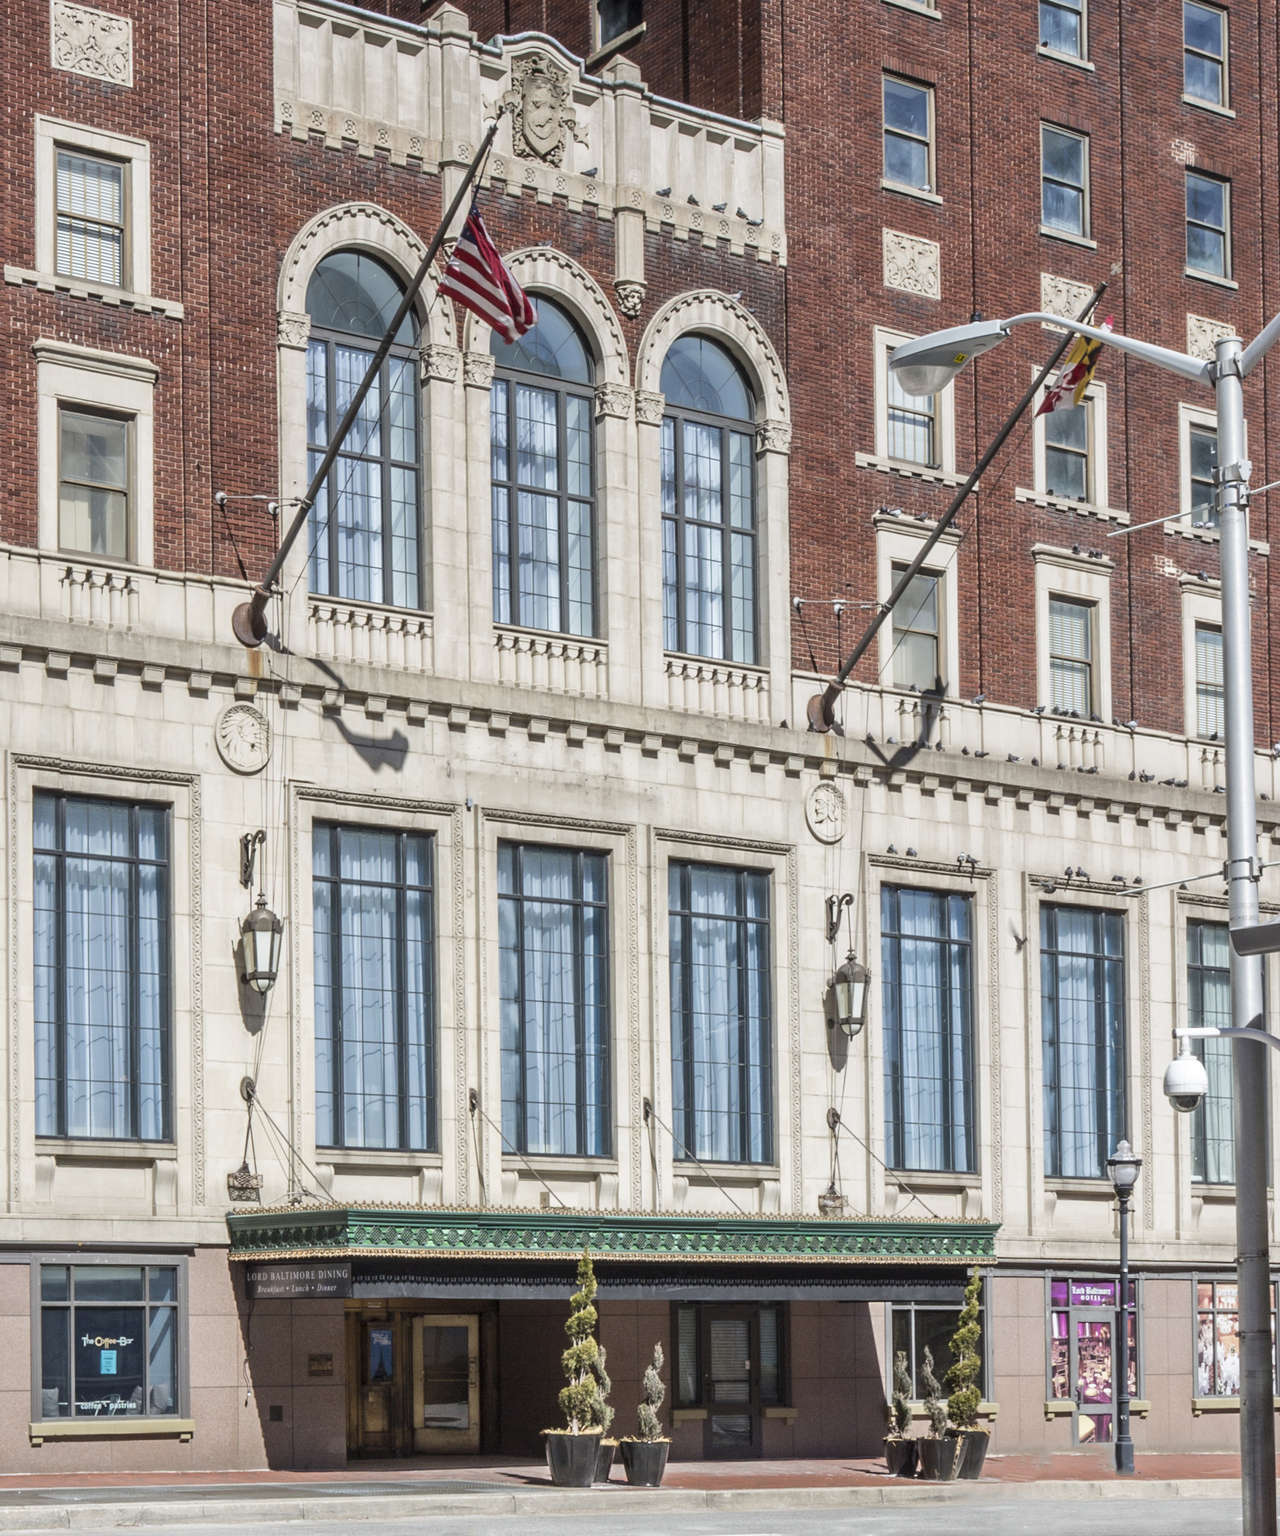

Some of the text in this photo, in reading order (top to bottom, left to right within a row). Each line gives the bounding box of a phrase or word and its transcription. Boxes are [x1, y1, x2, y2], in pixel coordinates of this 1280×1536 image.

[246, 1269, 348, 1282] LORD BALTIMORE DINING
[291, 1283, 310, 1292] Lunch
[316, 1283, 337, 1292] Dinner
[81, 1333, 94, 1347] The
[80, 1400, 137, 1410] coffee pastries
